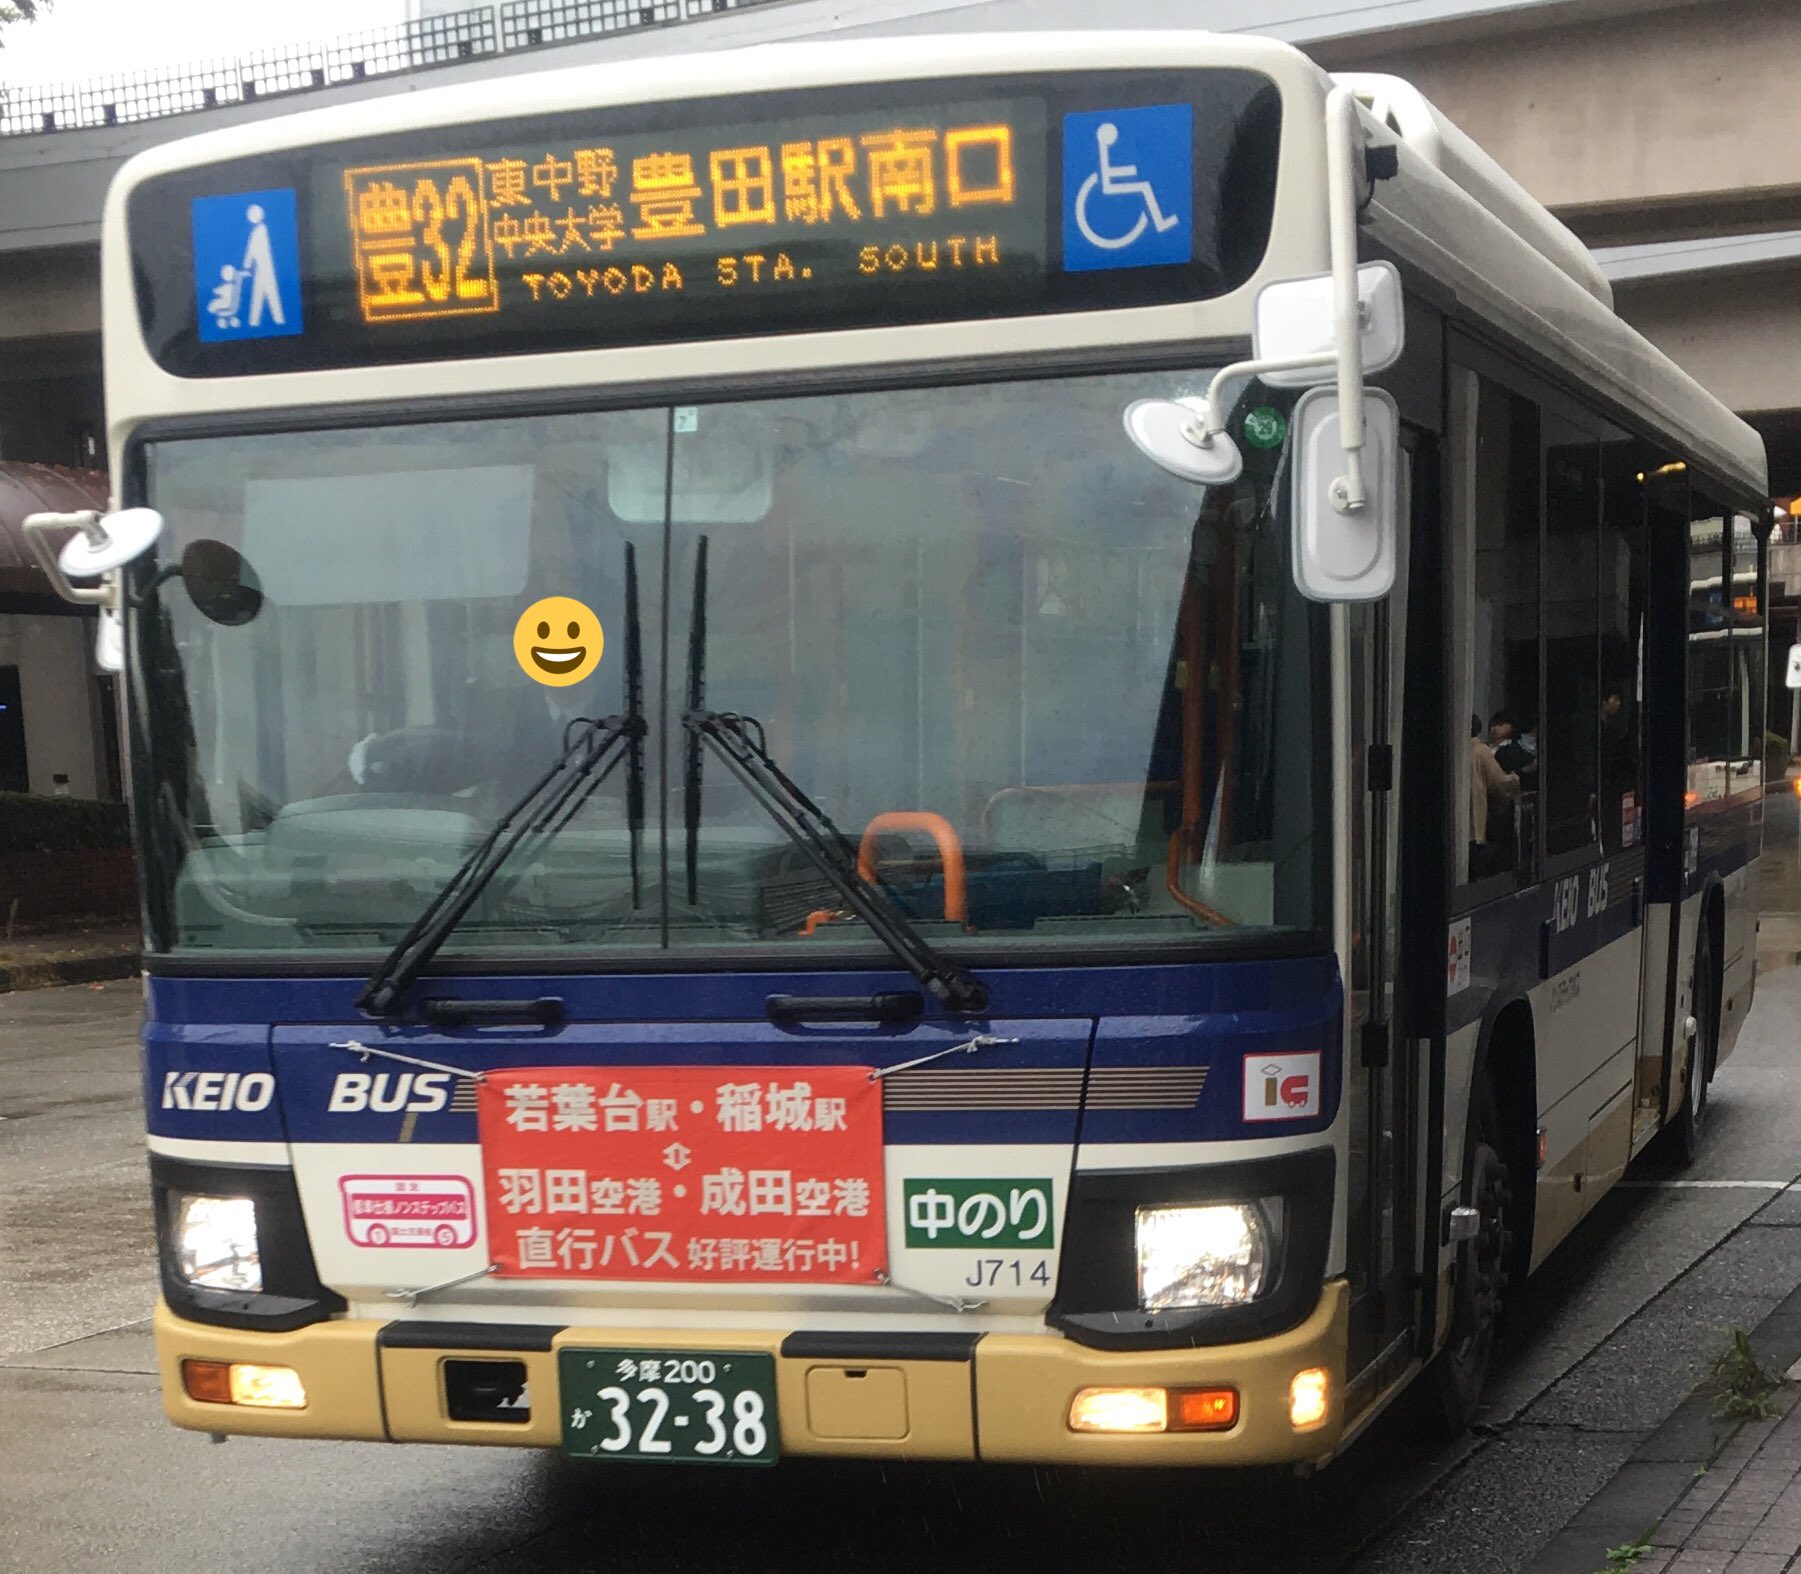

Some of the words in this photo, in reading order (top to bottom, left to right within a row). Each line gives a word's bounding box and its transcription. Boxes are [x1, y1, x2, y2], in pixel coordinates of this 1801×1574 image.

[486, 147, 619, 208] 東中野
[629, 124, 1015, 242] 豊田駅南口
[358, 175, 488, 305] 豊32
[494, 201, 626, 260] 中央大学
[521, 261, 684, 301] TOYODA
[717, 252, 813, 287] STA.
[858, 234, 998, 275] SOUTH
[161, 1071, 276, 1112] KEIO
[327, 1073, 451, 1113] BUS
[503, 1082, 848, 1132] 若葉台駅・稲城駅
[497, 1167, 871, 1217] 羽田空港・成田空港
[909, 1188, 1048, 1240] 中のり
[515, 1226, 680, 1270] 直行バス
[687, 1237, 860, 1271] 好評運行中!
[965, 1259, 1052, 1288] J714
[596, 1386, 768, 1457] 32-38
